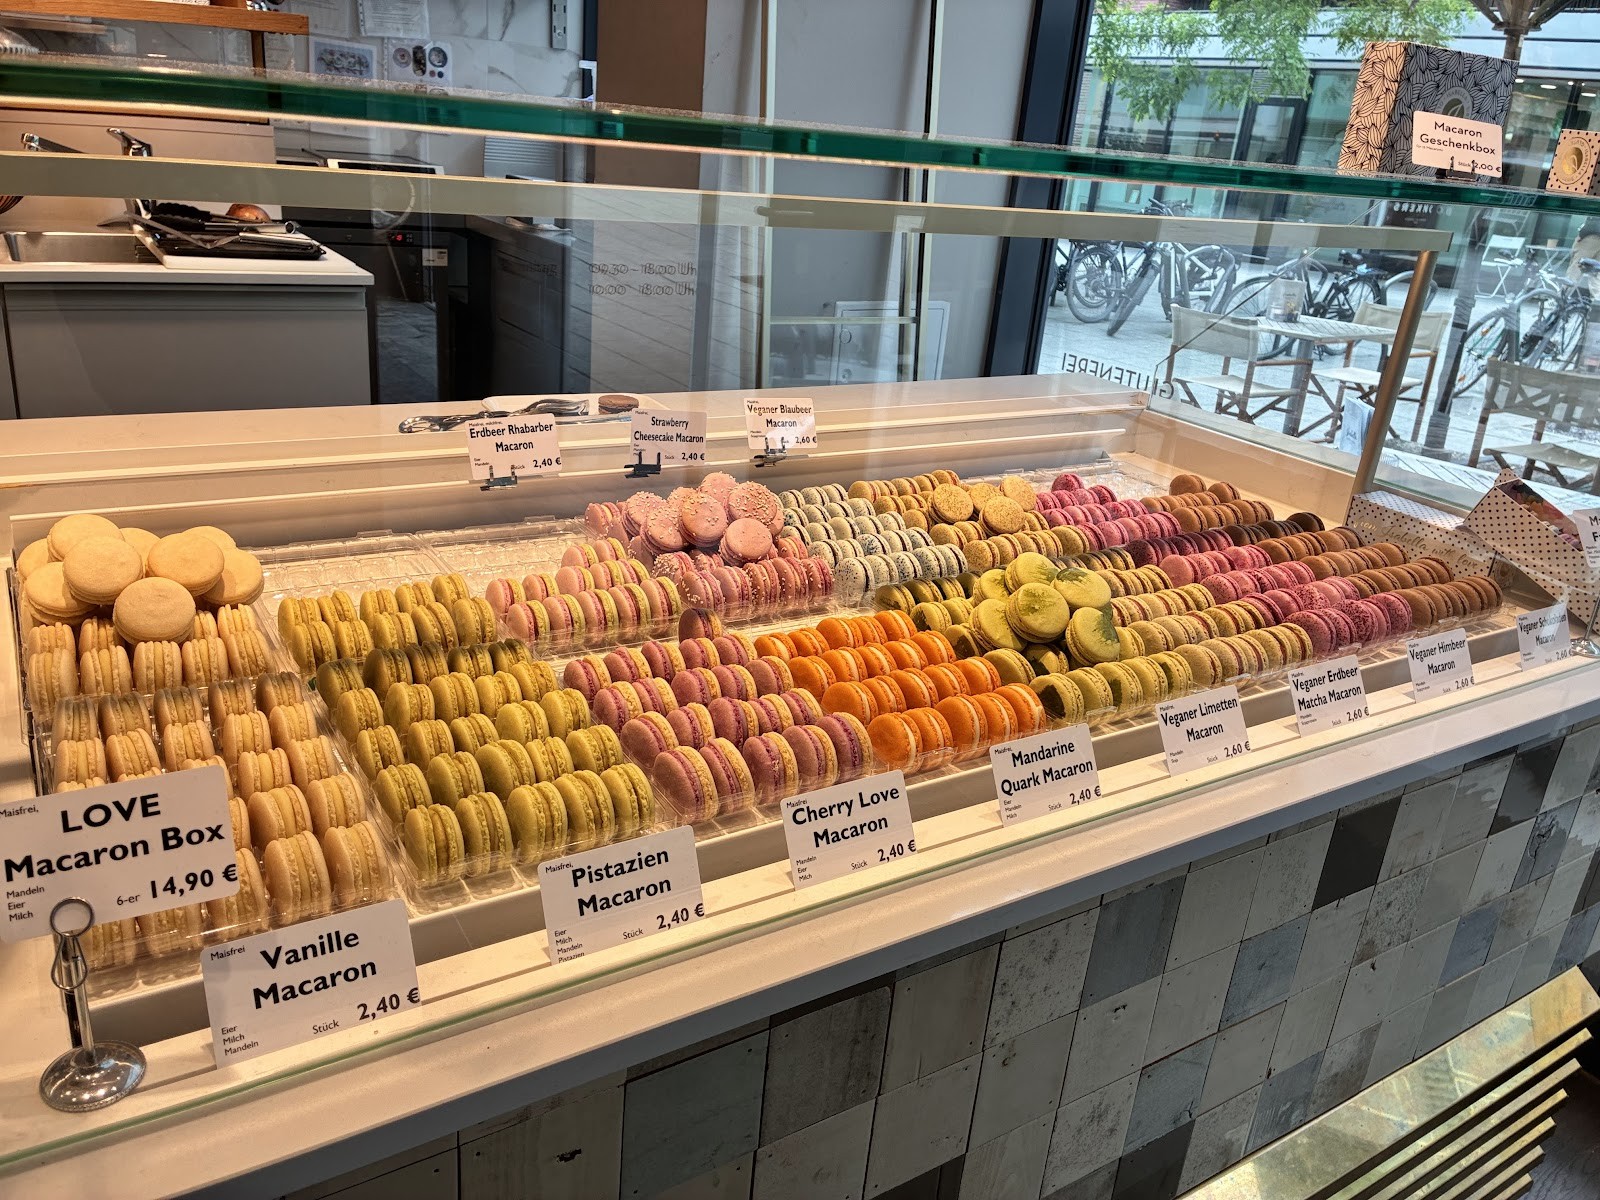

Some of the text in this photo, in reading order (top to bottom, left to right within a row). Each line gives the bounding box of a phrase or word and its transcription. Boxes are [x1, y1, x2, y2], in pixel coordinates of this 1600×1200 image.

[1434, 121, 1482, 138] Macaron
[1420, 133, 1496, 155] Geschenkbox
[1472, 161, 1493, 171] 2,00
[747, 404, 812, 416] Veganer Blaubeer
[469, 423, 553, 439] Erdbeer Rhabarber
[651, 416, 689, 430] Strawberry
[766, 418, 798, 428] Macaron
[634, 431, 704, 443] Cheesecake Macaron
[795, 436, 811, 445] 2,60
[495, 441, 534, 452] Macaron
[533, 458, 553, 469] 2,40
[555, 457, 562, 465] €
[681, 452, 698, 461] 2,40
[700, 453, 705, 461] €
[1409, 639, 1466, 662] Veganer Himbeer
[1428, 661, 1456, 675] Macaron
[1292, 666, 1358, 693] Veganer Erdbeer
[1455, 679, 1469, 690] 2,60
[1470, 676, 1475, 685] €
[1298, 686, 1362, 711] Matcha Macaron
[1161, 698, 1238, 728] Veganer Limetten
[1347, 708, 1363, 722] 2,60
[1364, 706, 1370, 716] €
[1186, 723, 1224, 742] Macaron
[1011, 741, 1075, 767] Mandarine
[1224, 743, 1243, 758] 2,60
[1244, 741, 1251, 751] €
[1001, 760, 1093, 796] Quark Macaron
[1048, 785, 1102, 811] Stück 2,40 €
[61, 793, 161, 833] LOVE
[792, 788, 900, 825] Cherry Love
[813, 816, 888, 848] Macaron
[4, 824, 225, 882] Macaron Box
[796, 855, 817, 866] Mandeln
[851, 839, 917, 871] Stück 2,40 €
[572, 850, 669, 888] Pistazien
[797, 866, 808, 874] Eier
[117, 864, 238, 905] 6-er 14,90 €
[799, 873, 812, 882] Milch
[6, 886, 45, 899] Mandeln
[577, 879, 672, 917] Macaron
[8, 901, 26, 910] Eier
[9, 911, 33, 922] Milch
[623, 903, 705, 940] Stück 2,40 €
[554, 929, 567, 938] Eier
[555, 936, 573, 946] Milch
[211, 945, 245, 961] Maisfrei
[260, 930, 360, 969] Vanille
[557, 943, 583, 955] Mandeln
[558, 951, 585, 963] Pistazien
[253, 961, 377, 1009] Macaron
[312, 987, 420, 1035] Stück 2,40 €
[221, 1025, 238, 1035] Eier
[223, 1034, 245, 1045] Milch
[224, 1040, 259, 1056] Mandeln
